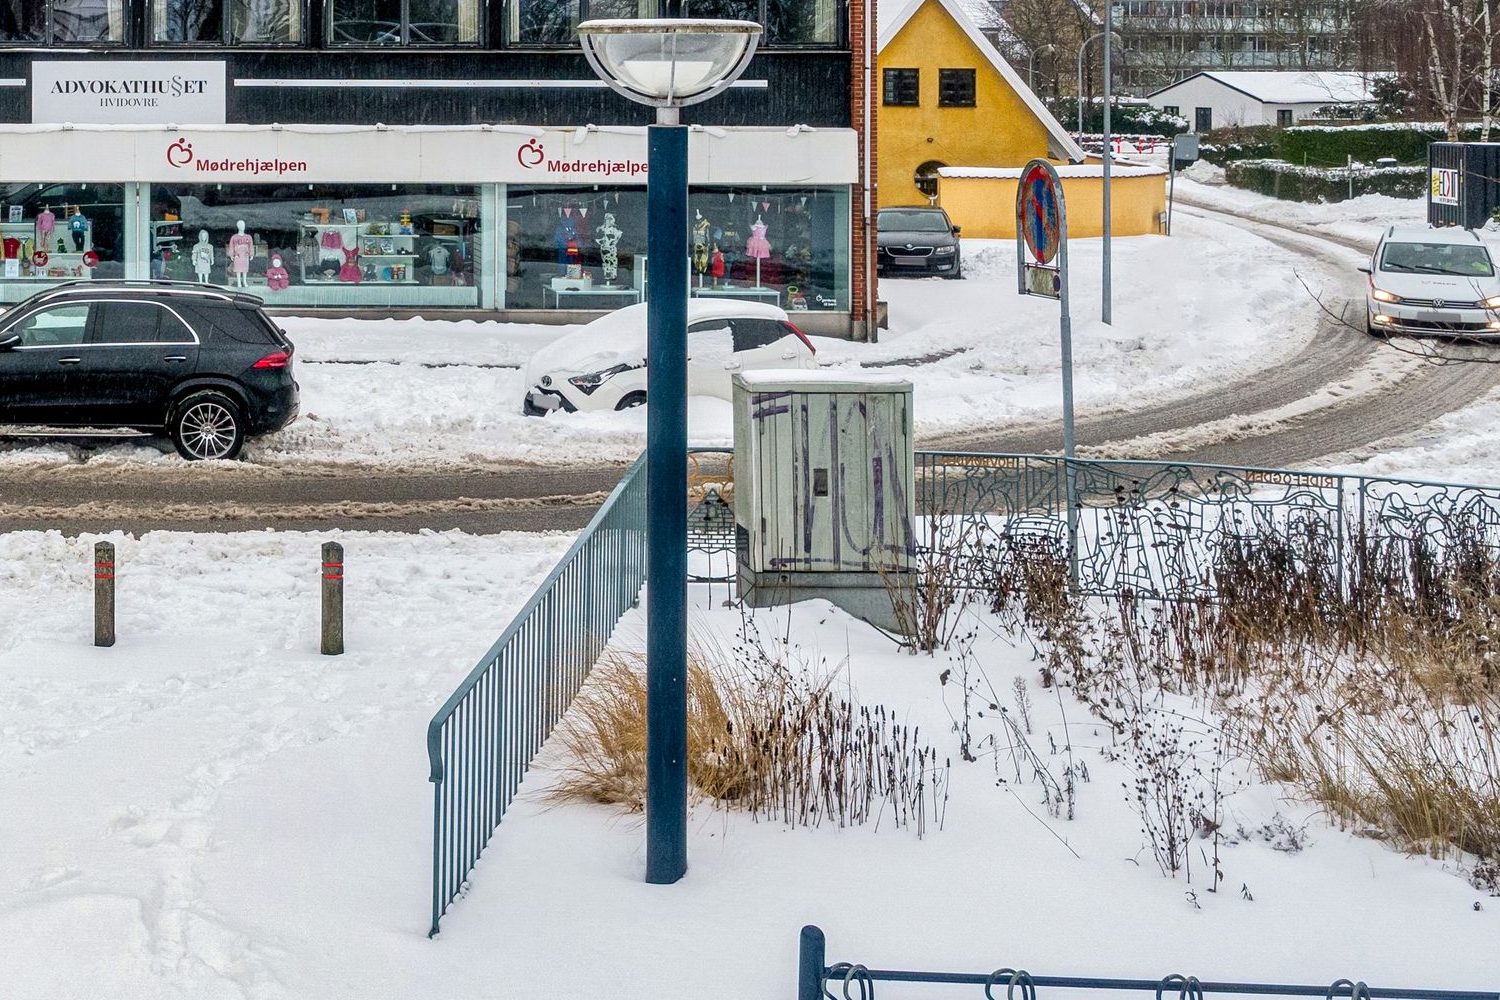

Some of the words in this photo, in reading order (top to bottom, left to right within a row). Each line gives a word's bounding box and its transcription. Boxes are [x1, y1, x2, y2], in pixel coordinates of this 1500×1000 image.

[100, 98, 158, 107] HVIDOVRE
[196, 159, 307, 175] Mødrehjælpen
[547, 160, 648, 176] Mødrehjælpe
